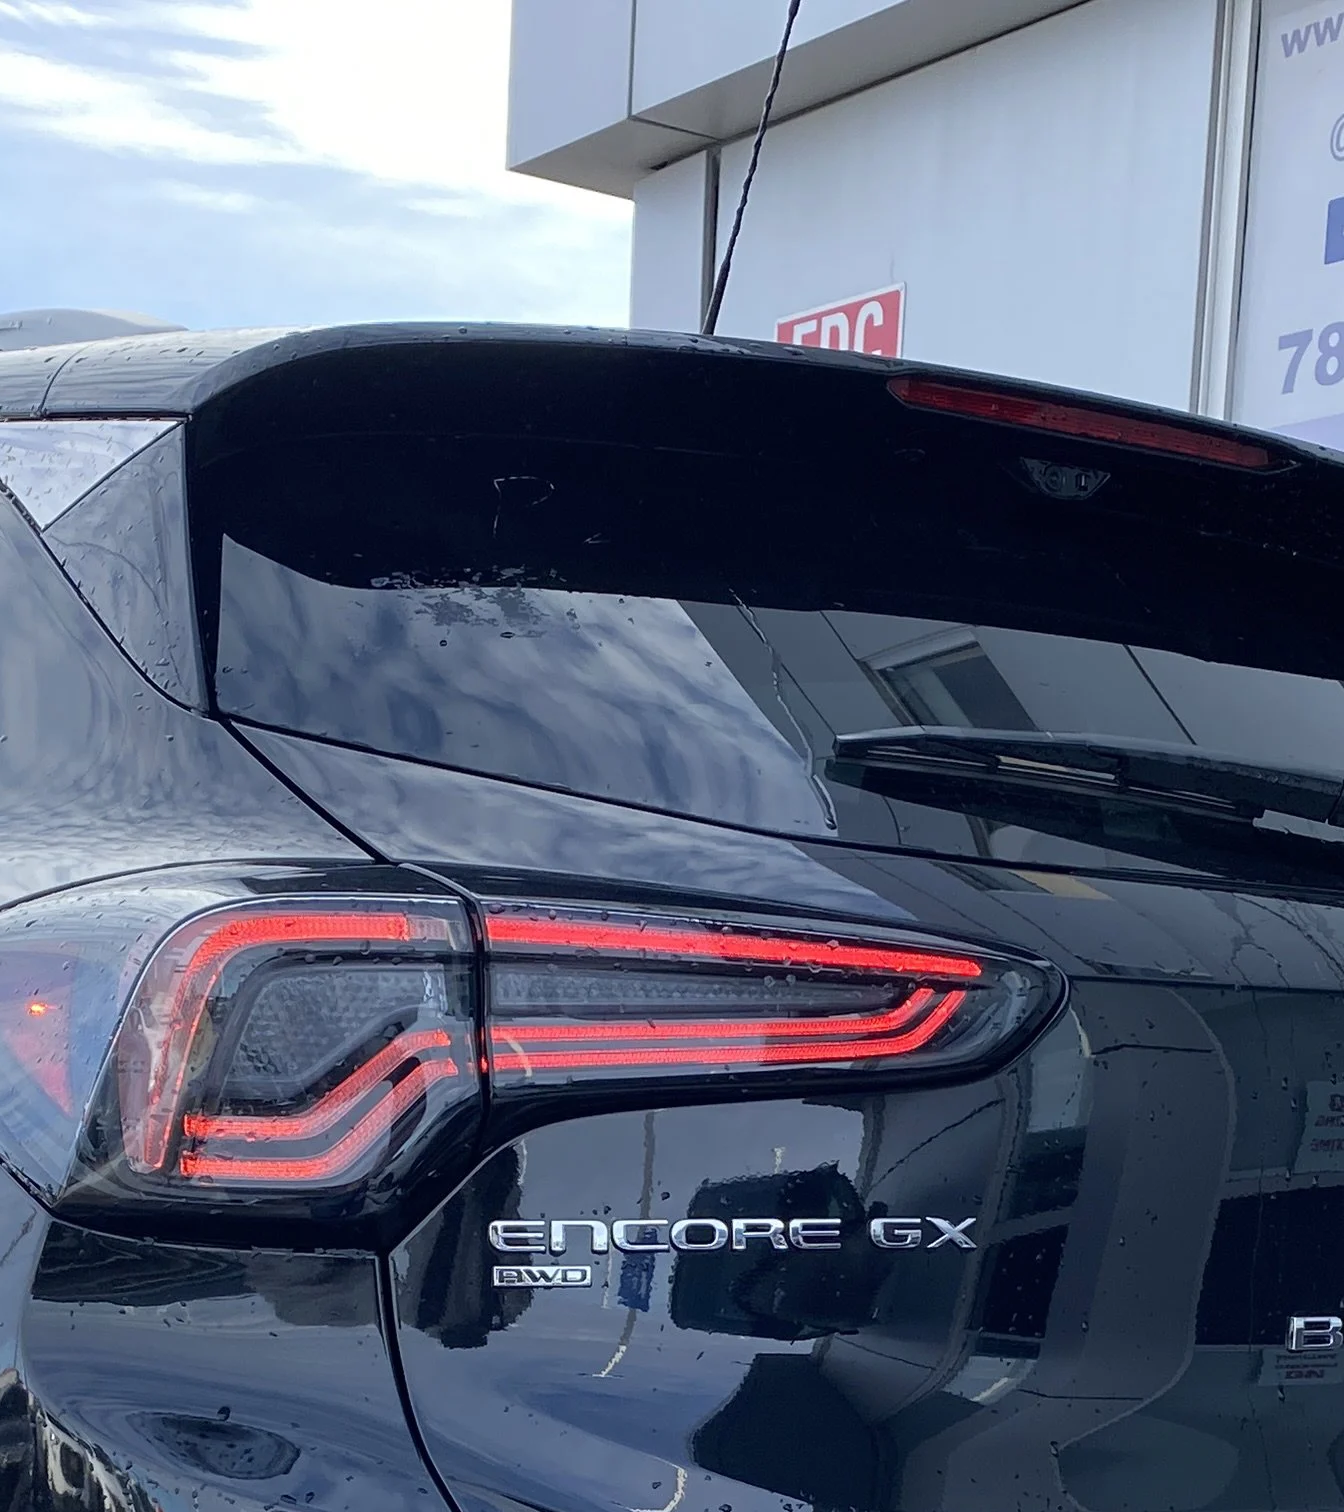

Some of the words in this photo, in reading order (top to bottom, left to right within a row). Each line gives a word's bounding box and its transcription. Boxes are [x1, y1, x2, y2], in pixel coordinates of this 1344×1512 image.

[792, 300, 884, 356] DC
[488, 1218, 842, 1254] ENCORE
[871, 1217, 978, 1250] GX
[496, 1267, 588, 1284] AWD
